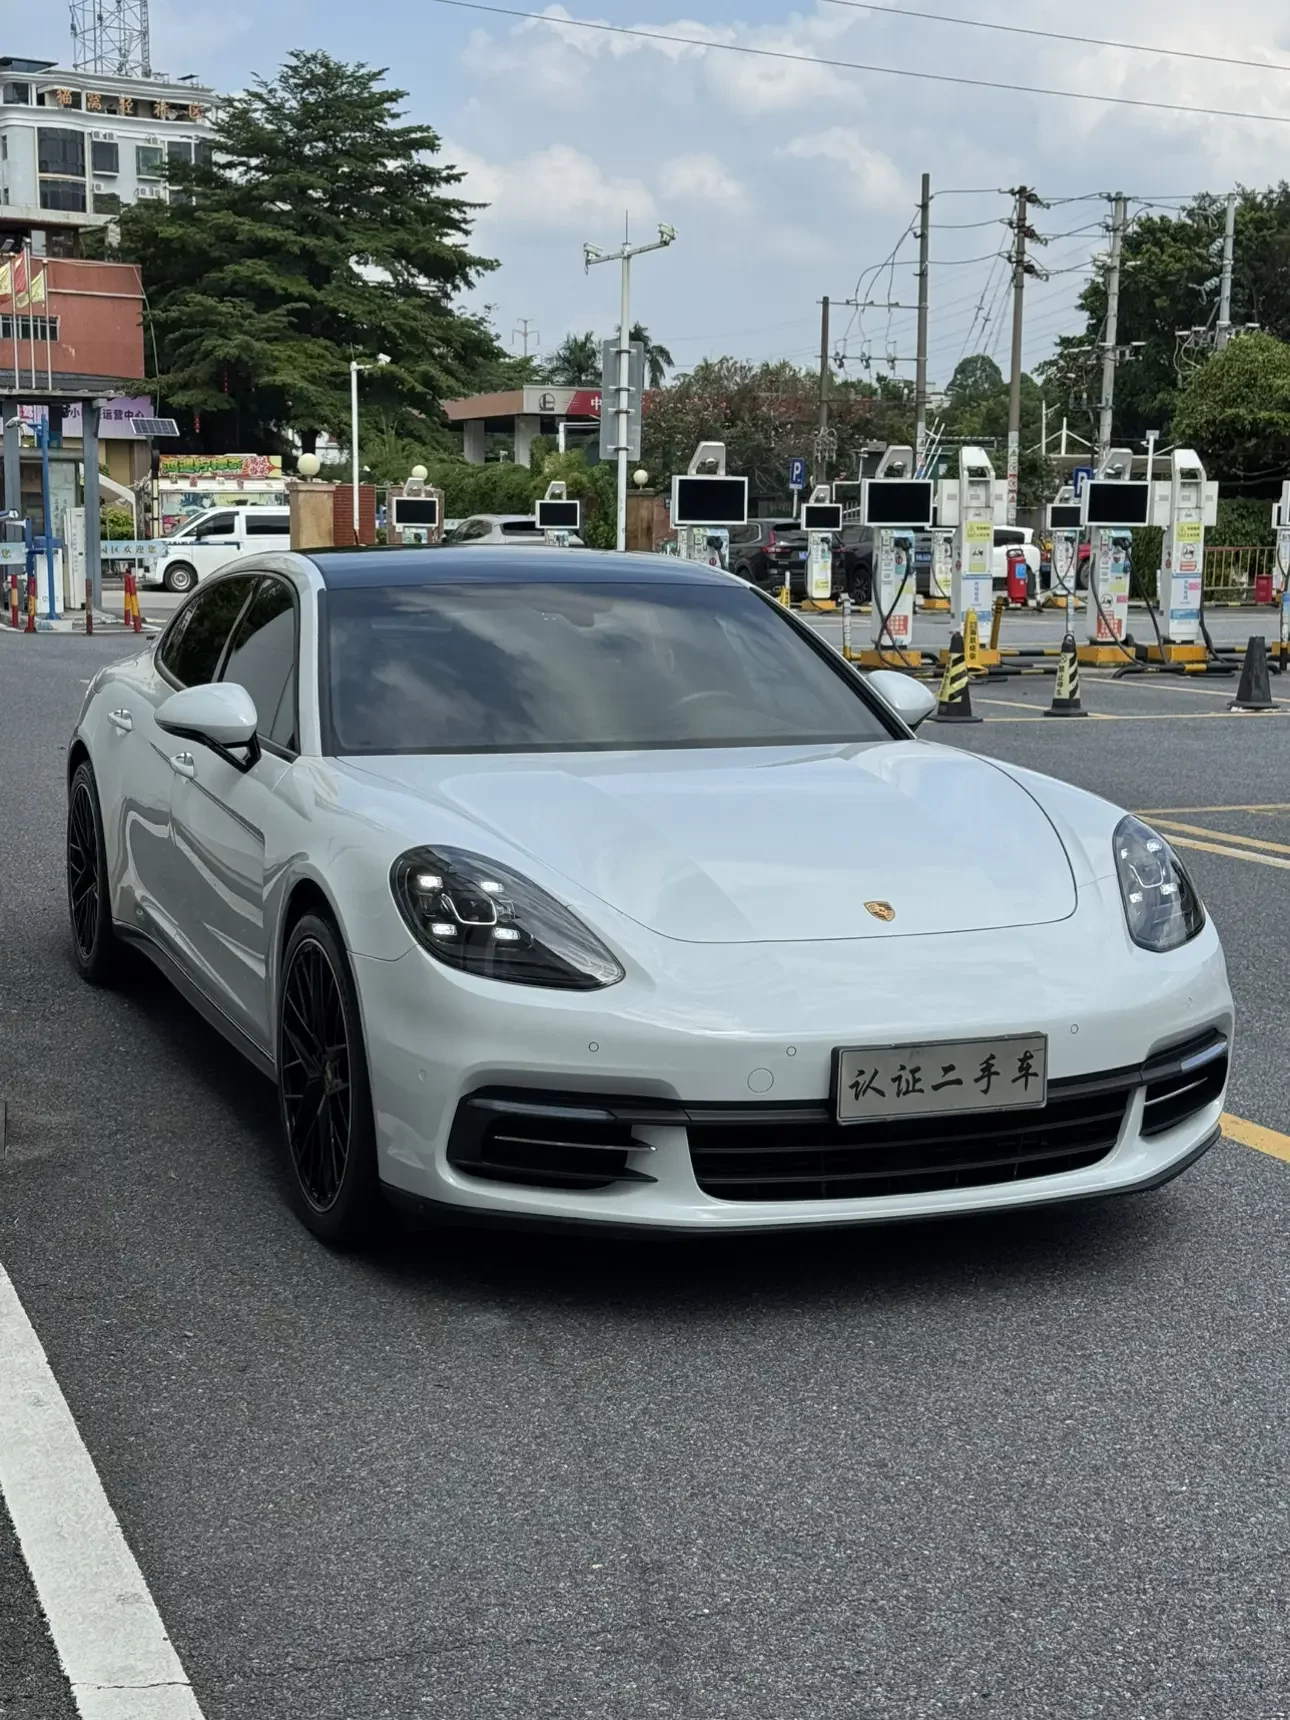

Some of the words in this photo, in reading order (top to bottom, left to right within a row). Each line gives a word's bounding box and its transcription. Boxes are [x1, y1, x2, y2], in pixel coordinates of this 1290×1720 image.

[793, 461, 802, 482] P
[848, 1049, 1039, 1101] 认证二手车
